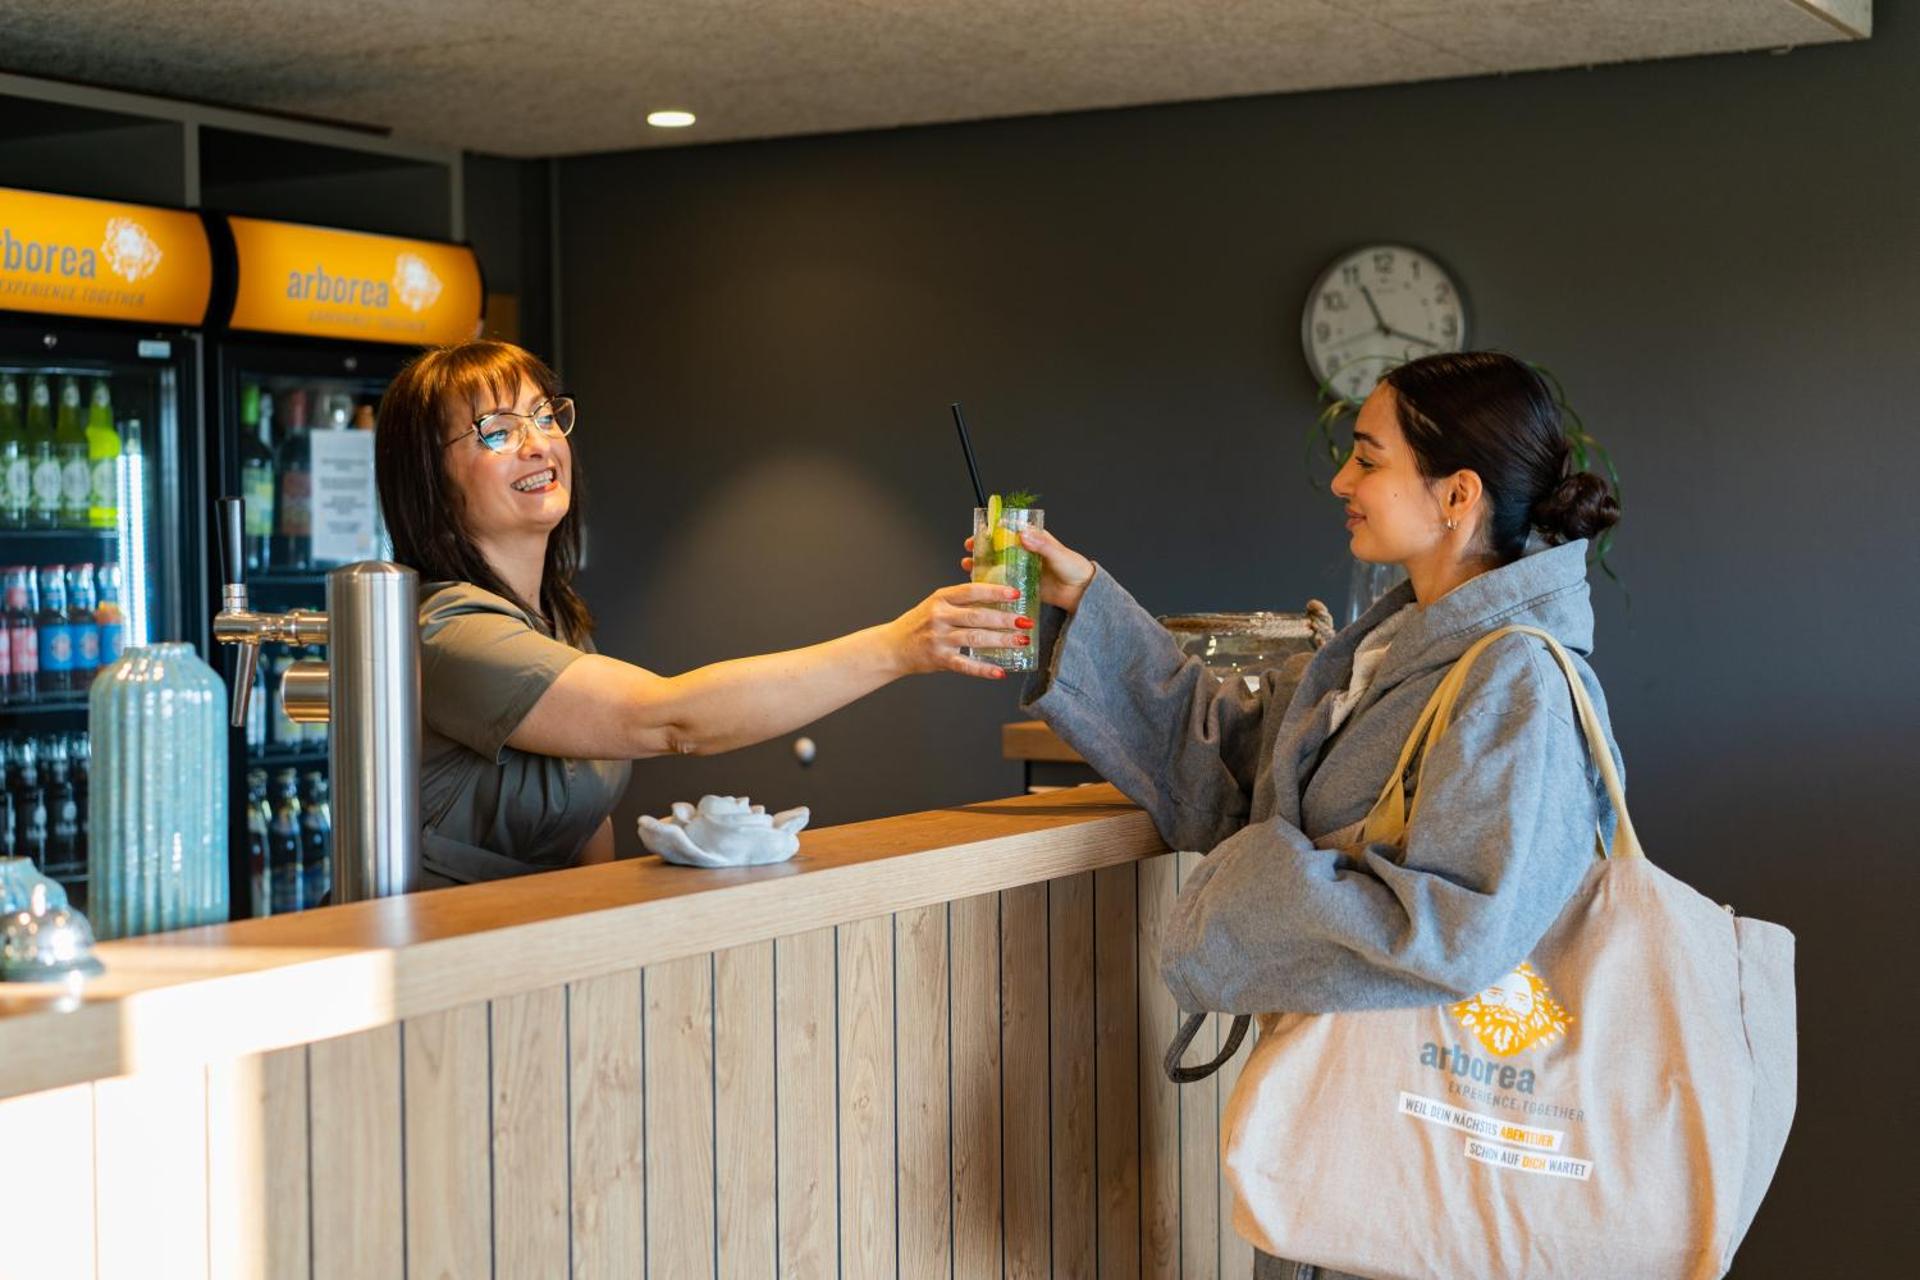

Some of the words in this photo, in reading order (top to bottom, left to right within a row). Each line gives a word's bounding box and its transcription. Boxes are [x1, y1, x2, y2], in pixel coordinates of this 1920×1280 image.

[0, 227, 96, 279] borea
[287, 262, 390, 309] arborea
[1419, 1041, 1536, 1095] arborea
[1405, 1098, 1428, 1115] WEIL
[1430, 1105, 1451, 1121] DEIN
[1500, 1150, 1520, 1166] AUF
[1521, 1154, 1546, 1169] DICH
[1548, 1159, 1587, 1177] WARTET
